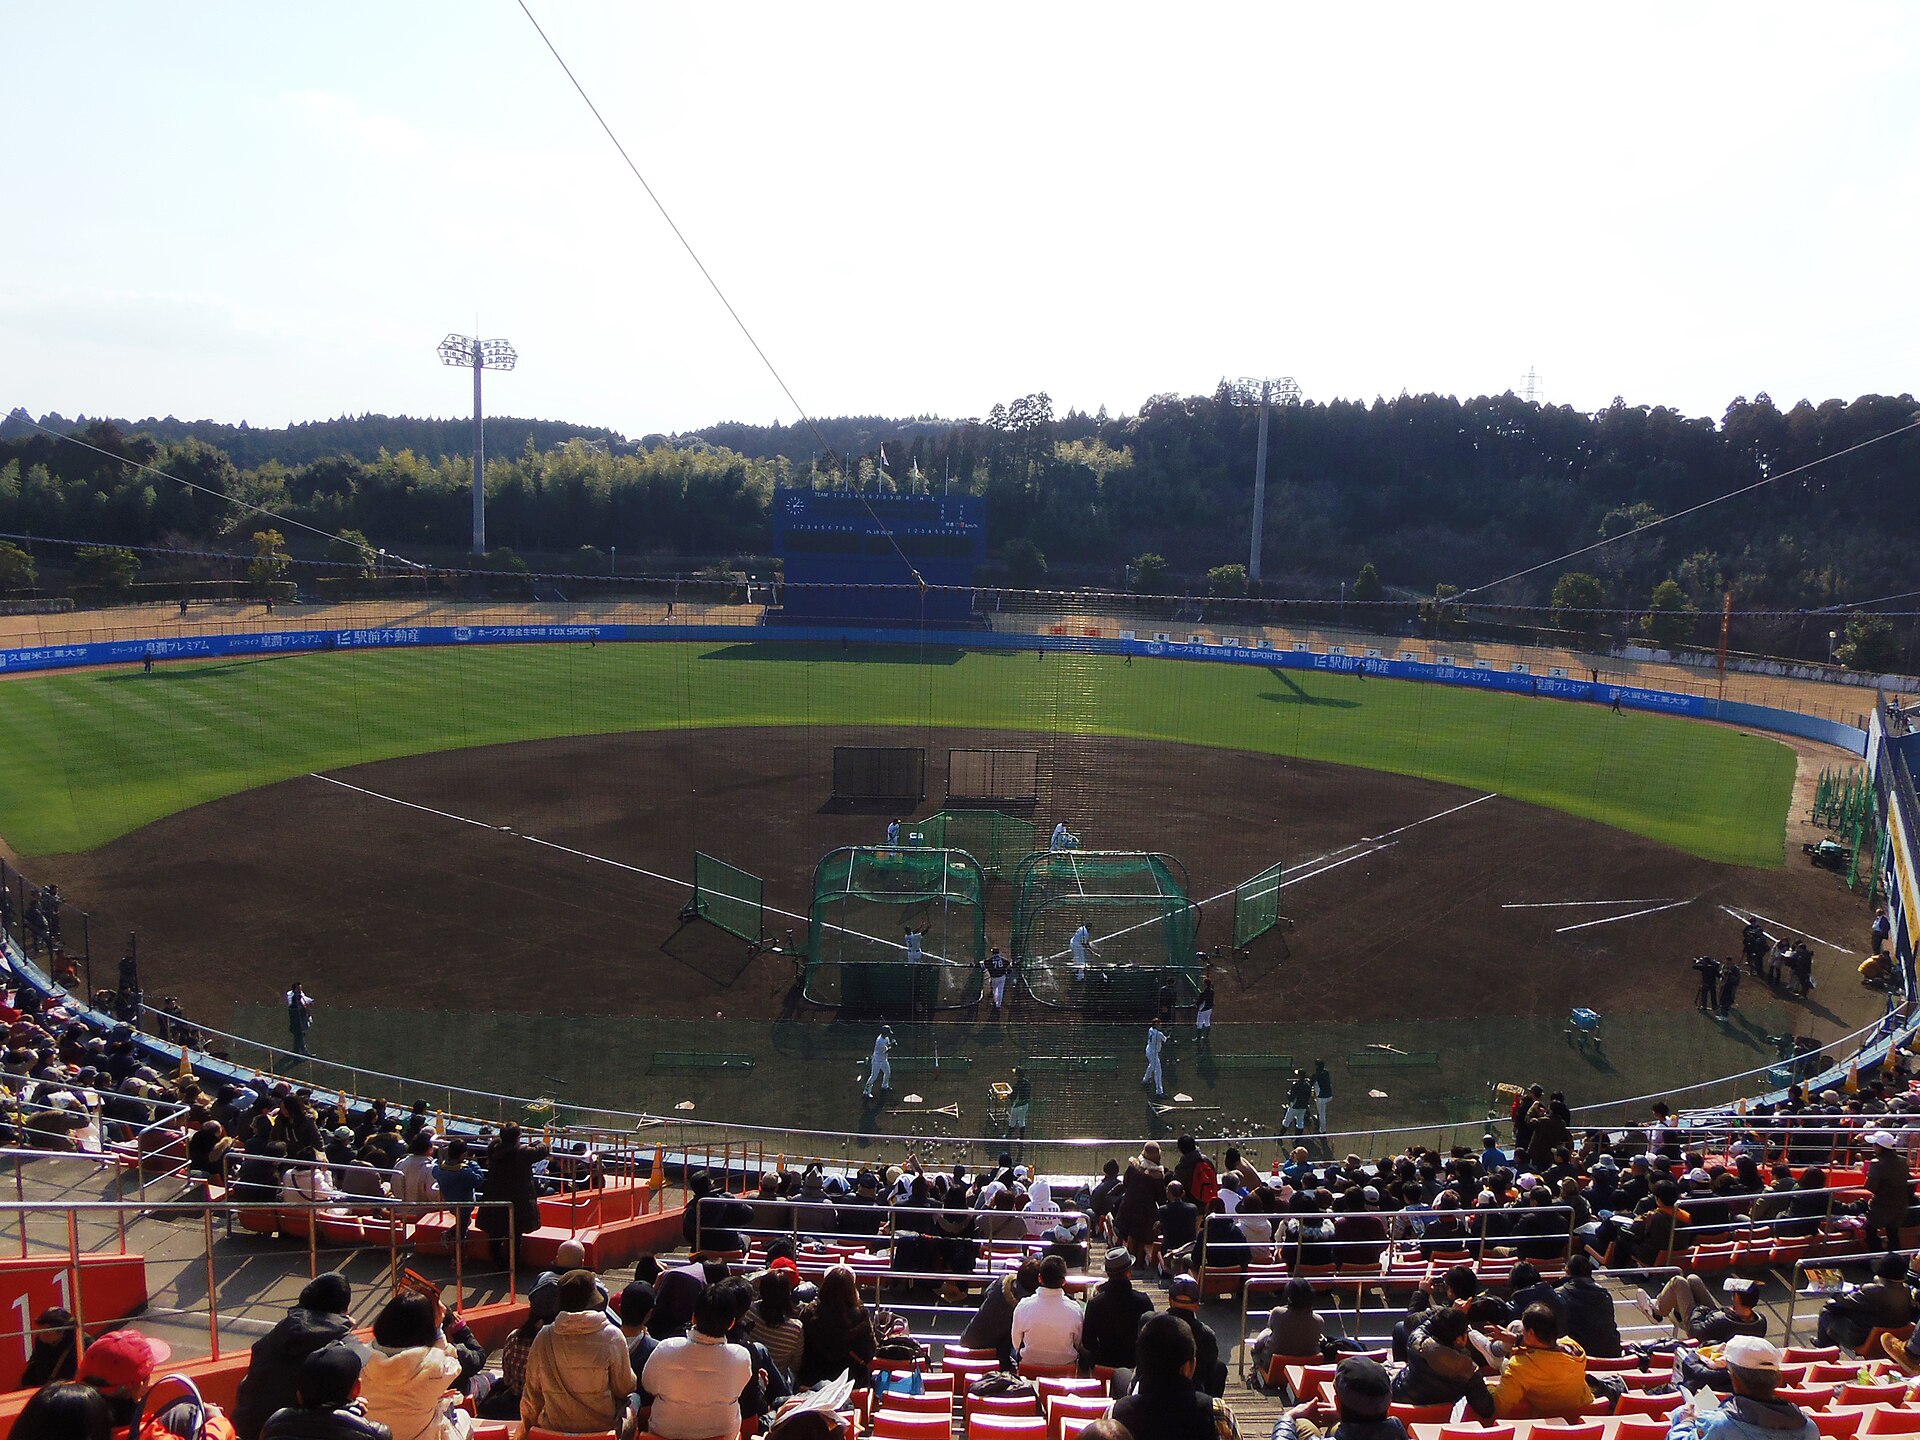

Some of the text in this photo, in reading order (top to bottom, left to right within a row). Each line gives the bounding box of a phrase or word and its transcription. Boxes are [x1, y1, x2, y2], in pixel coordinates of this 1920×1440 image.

[353, 628, 419, 644] 駅前不動産
[478, 628, 545, 637] ホークス完全生中継
[549, 628, 565, 636] FOX
[8, 648, 87, 662] 久留米工業大学
[1168, 644, 1283, 661] ホークス完全生中継 FOX SPORTS
[1328, 656, 1389, 674] 駅前不動産
[1536, 678, 1589, 693] 皇潤プレミア
[1621, 689, 1689, 706] 久留米工業大学
[11, 1268, 71, 1362] 11
